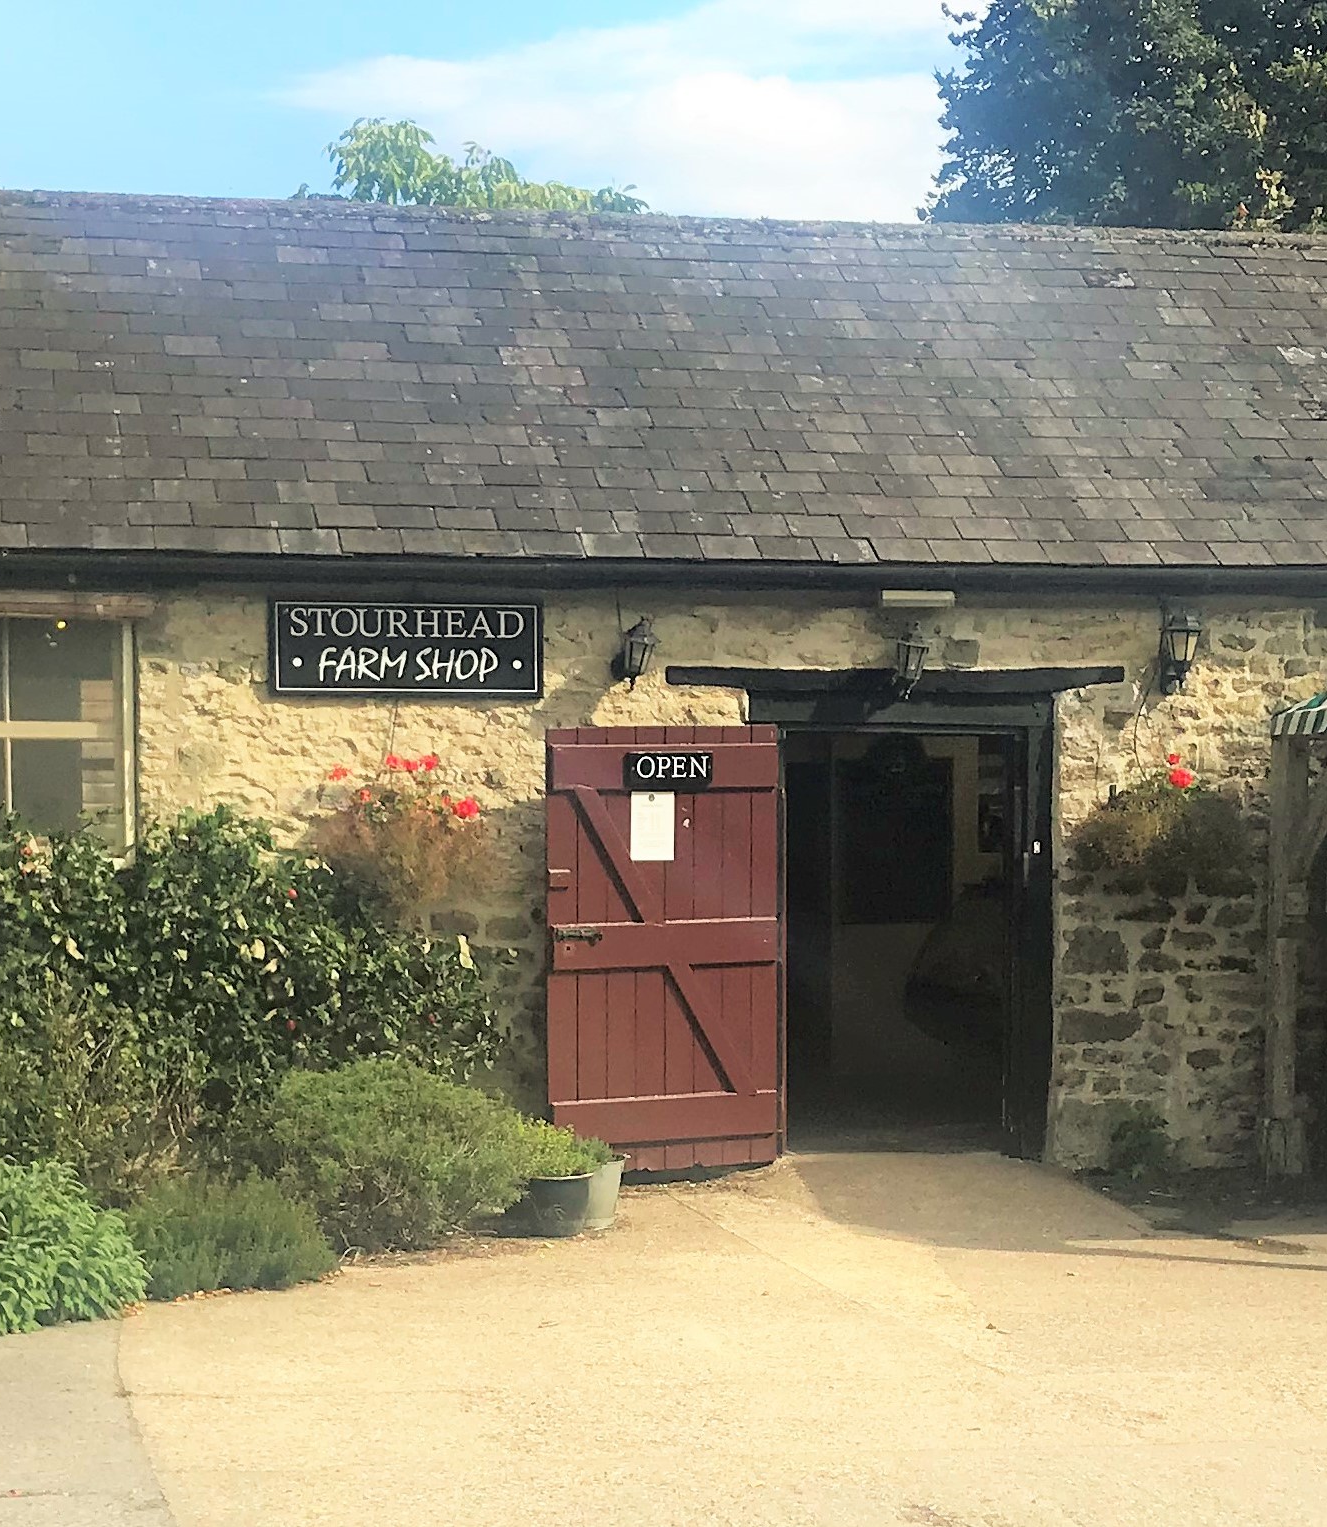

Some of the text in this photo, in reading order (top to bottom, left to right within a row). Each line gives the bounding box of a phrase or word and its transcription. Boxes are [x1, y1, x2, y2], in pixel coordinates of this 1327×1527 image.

[289, 607, 525, 639] STOURHEAD
[318, 646, 499, 683] FARM SHOP
[636, 755, 710, 779] OPEN
